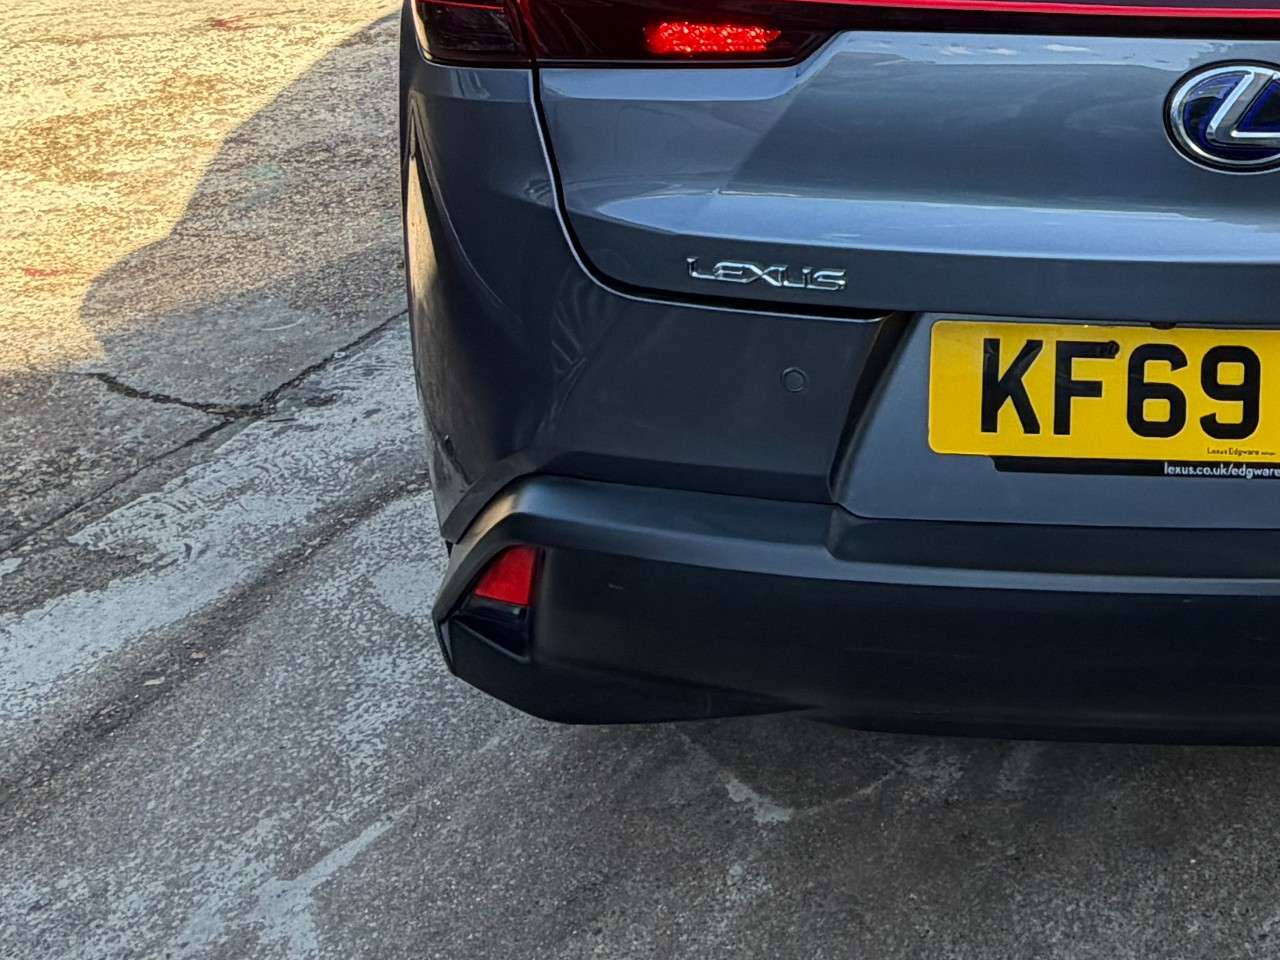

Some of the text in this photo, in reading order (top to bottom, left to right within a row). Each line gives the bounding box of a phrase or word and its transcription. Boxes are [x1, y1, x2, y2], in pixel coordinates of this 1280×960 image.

[687, 257, 847, 291] LEXUS
[980, 338, 1261, 440] KF69
[1228, 447, 1260, 457] Edgware
